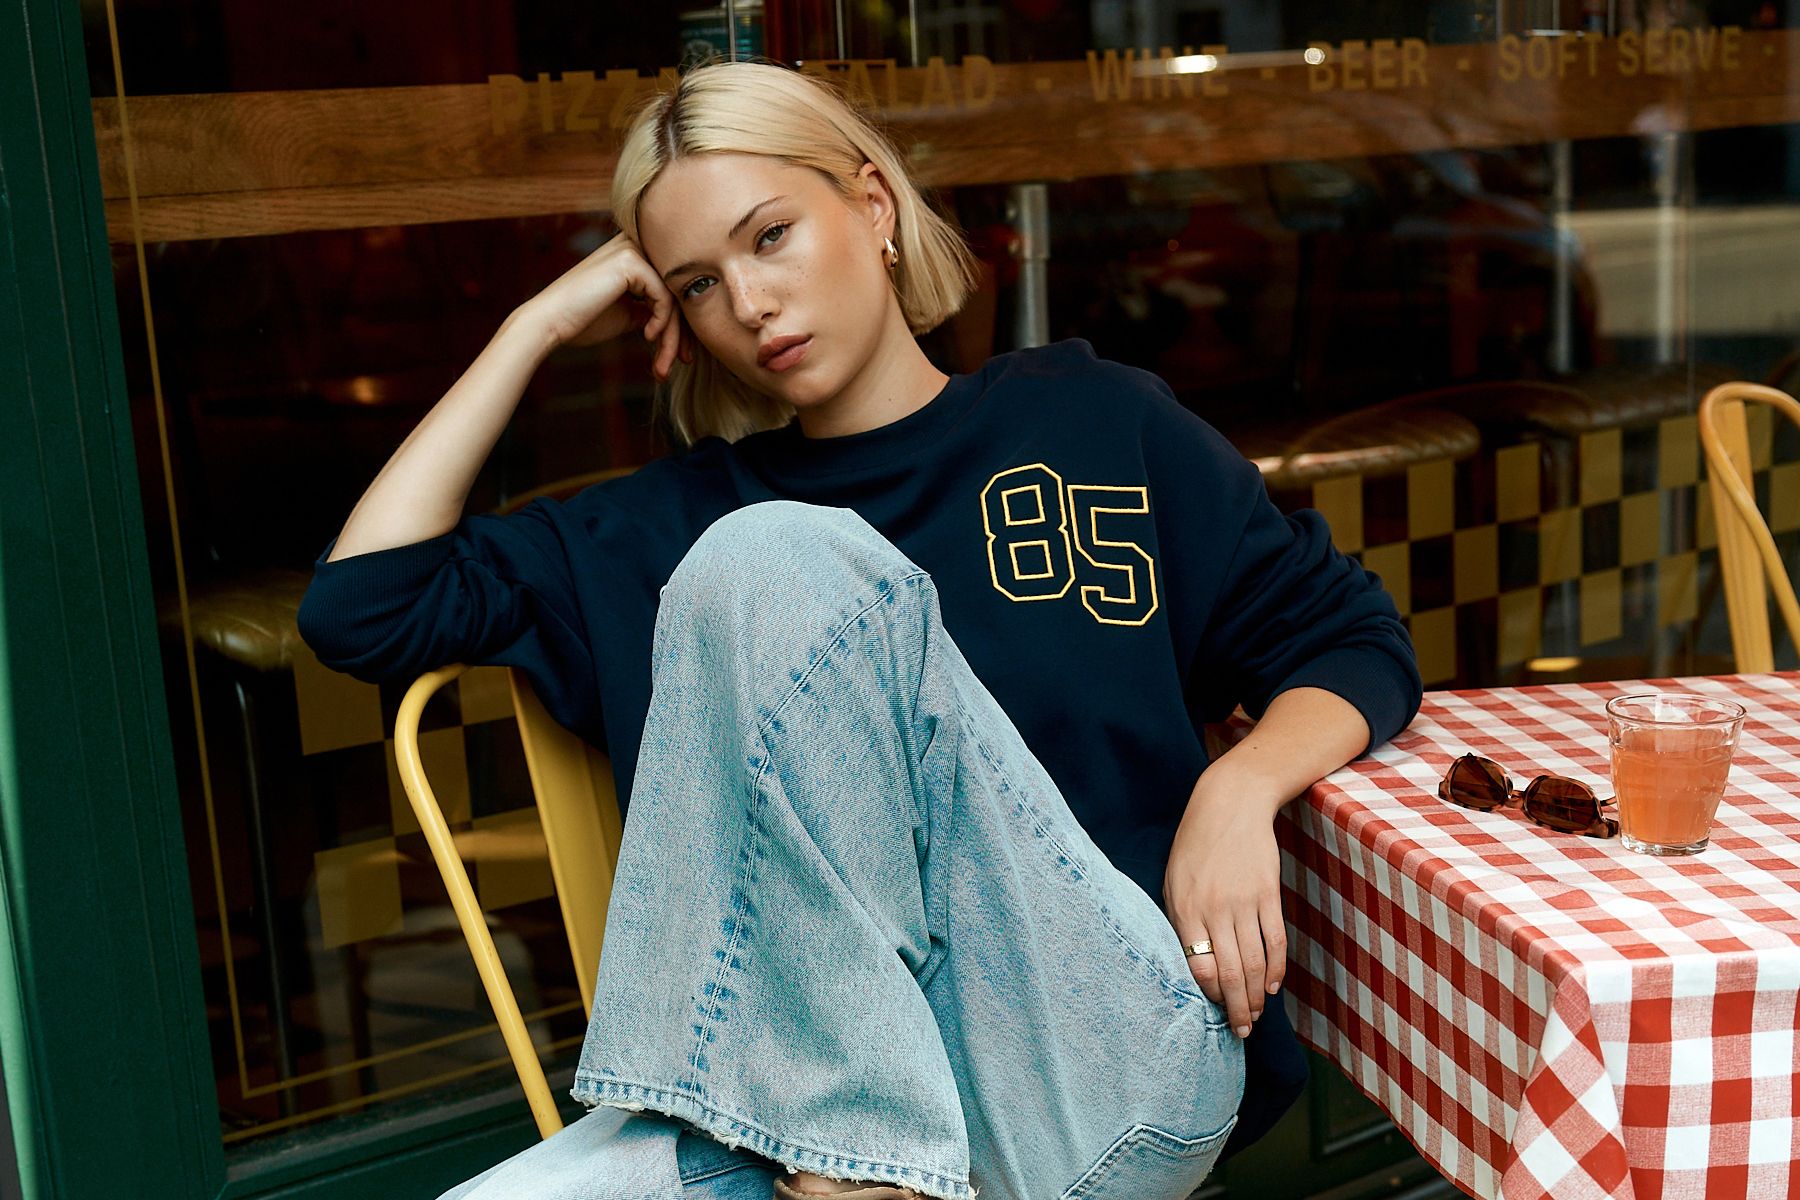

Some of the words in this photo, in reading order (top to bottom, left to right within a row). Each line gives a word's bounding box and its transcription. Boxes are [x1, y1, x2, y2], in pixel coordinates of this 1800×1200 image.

[1087, 44, 1229, 102] WINE
[1308, 39, 1428, 91] BEER
[1500, 32, 1602, 82] SOFT
[1617, 25, 1743, 76] SERVE
[980, 462, 1159, 626] 85
